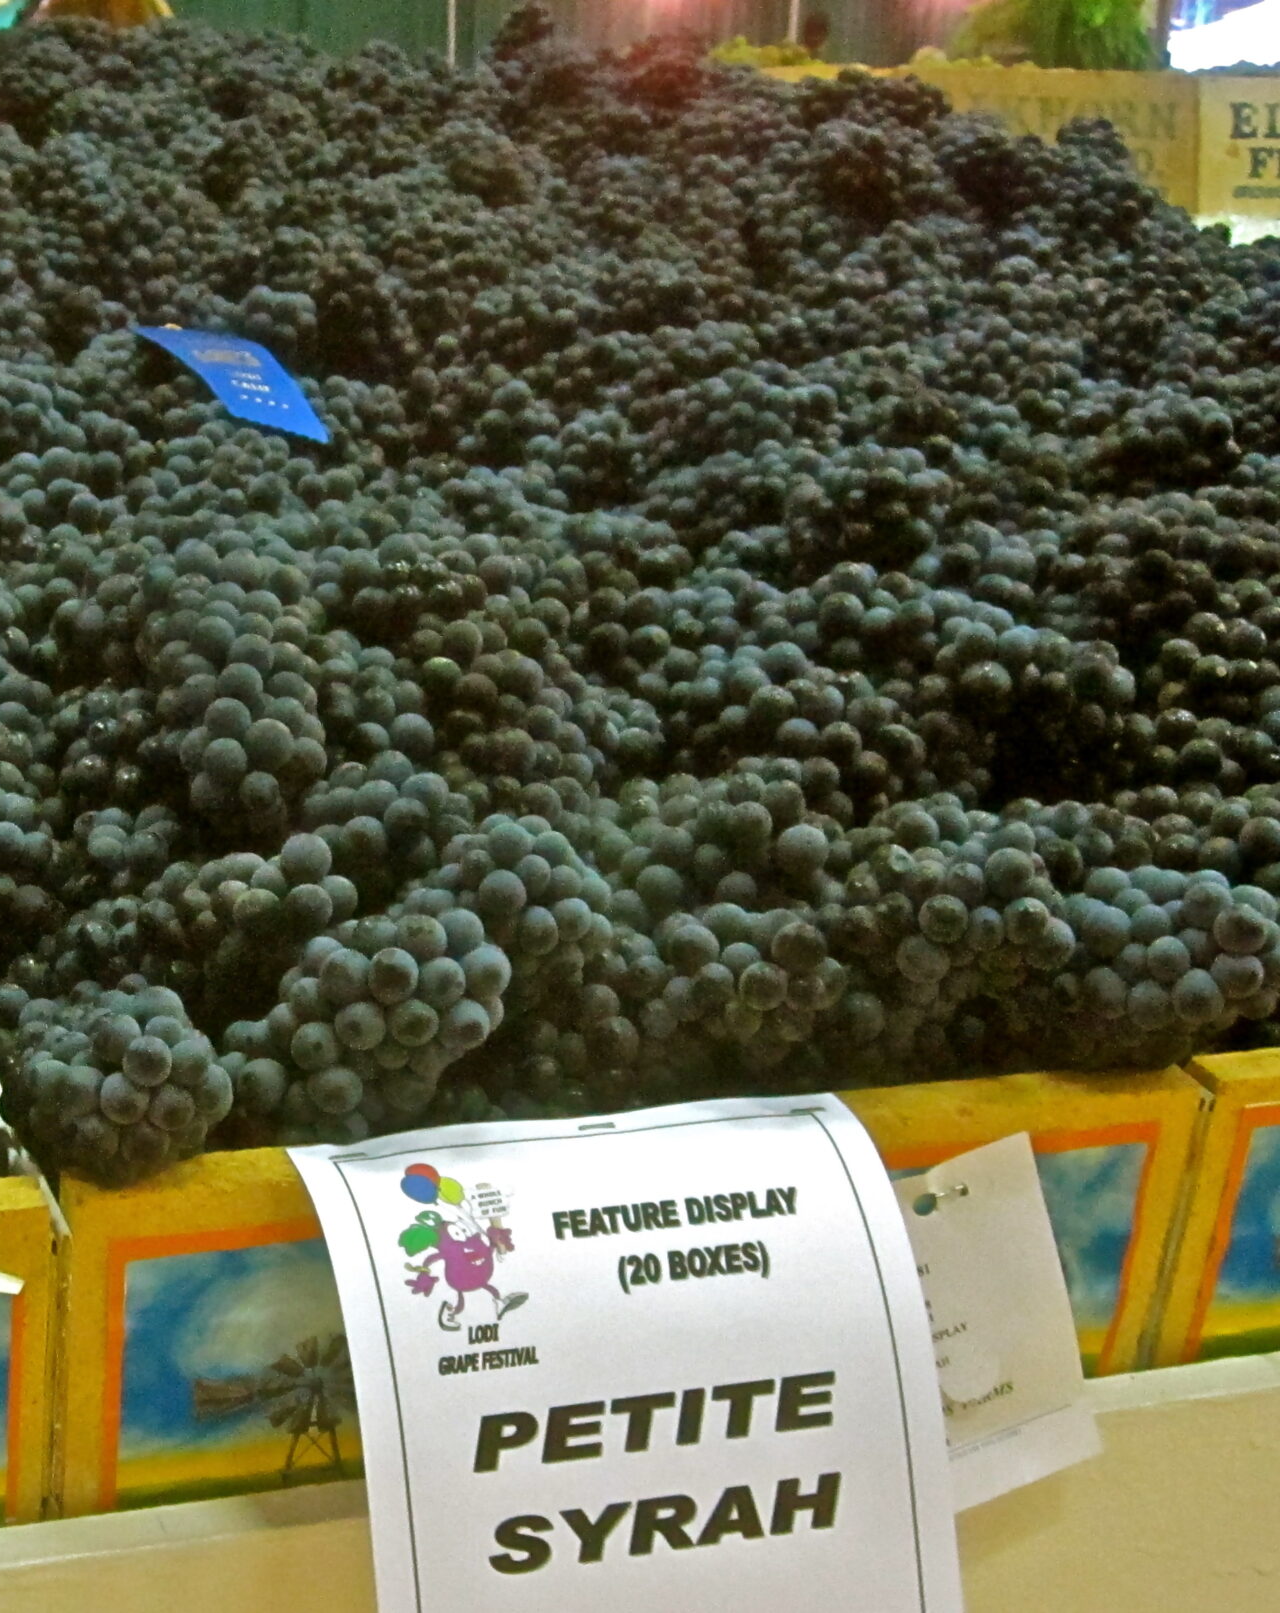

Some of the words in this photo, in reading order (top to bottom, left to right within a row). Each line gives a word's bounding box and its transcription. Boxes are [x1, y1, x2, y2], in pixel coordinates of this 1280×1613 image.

[552, 1199, 682, 1240] FEATURE
[684, 1187, 796, 1226] DISPLAY
[618, 1253, 661, 1294] (20
[667, 1240, 770, 1279] BOXES)
[468, 1323, 499, 1345] LODI
[438, 1353, 480, 1376] GRAPE
[482, 1346, 539, 1370] FESTIVAL
[473, 1371, 835, 1473] PETITE
[488, 1472, 840, 1574] SYRAH
